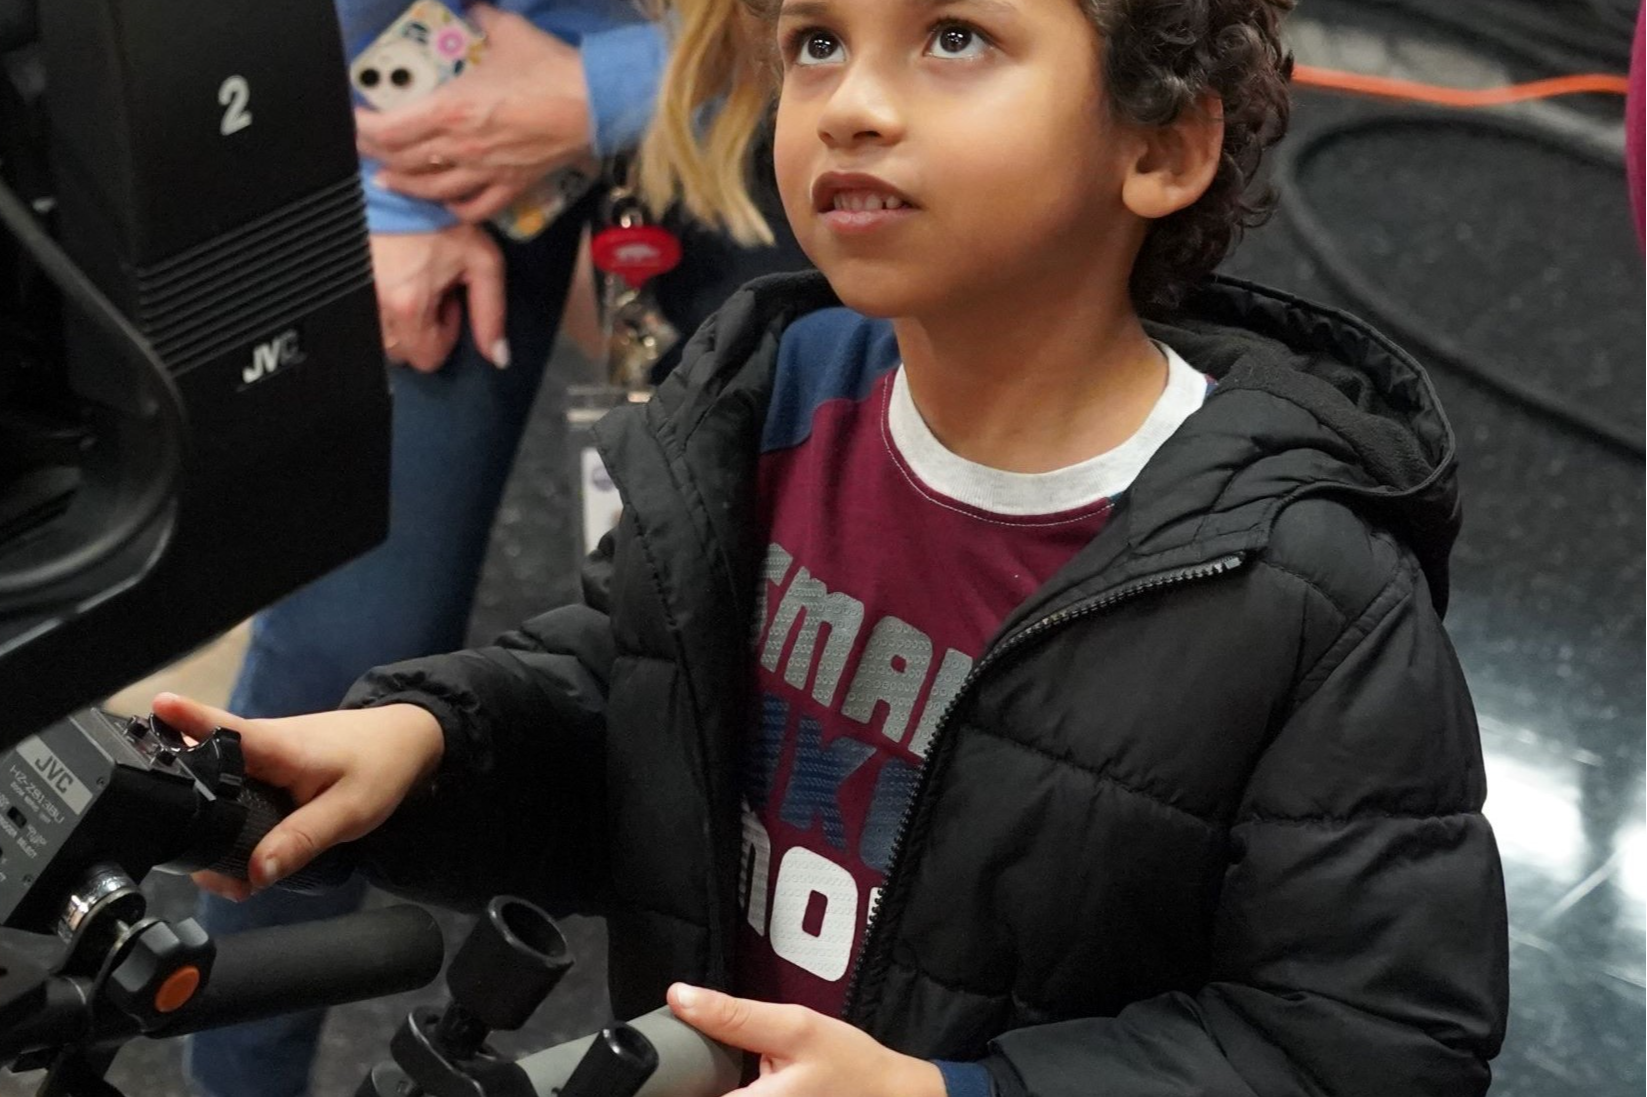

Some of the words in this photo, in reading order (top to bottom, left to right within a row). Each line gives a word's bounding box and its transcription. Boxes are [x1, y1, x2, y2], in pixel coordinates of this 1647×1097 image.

[217, 73, 253, 136] 2
[242, 328, 302, 384] JVC
[33, 755, 74, 796] JVC
